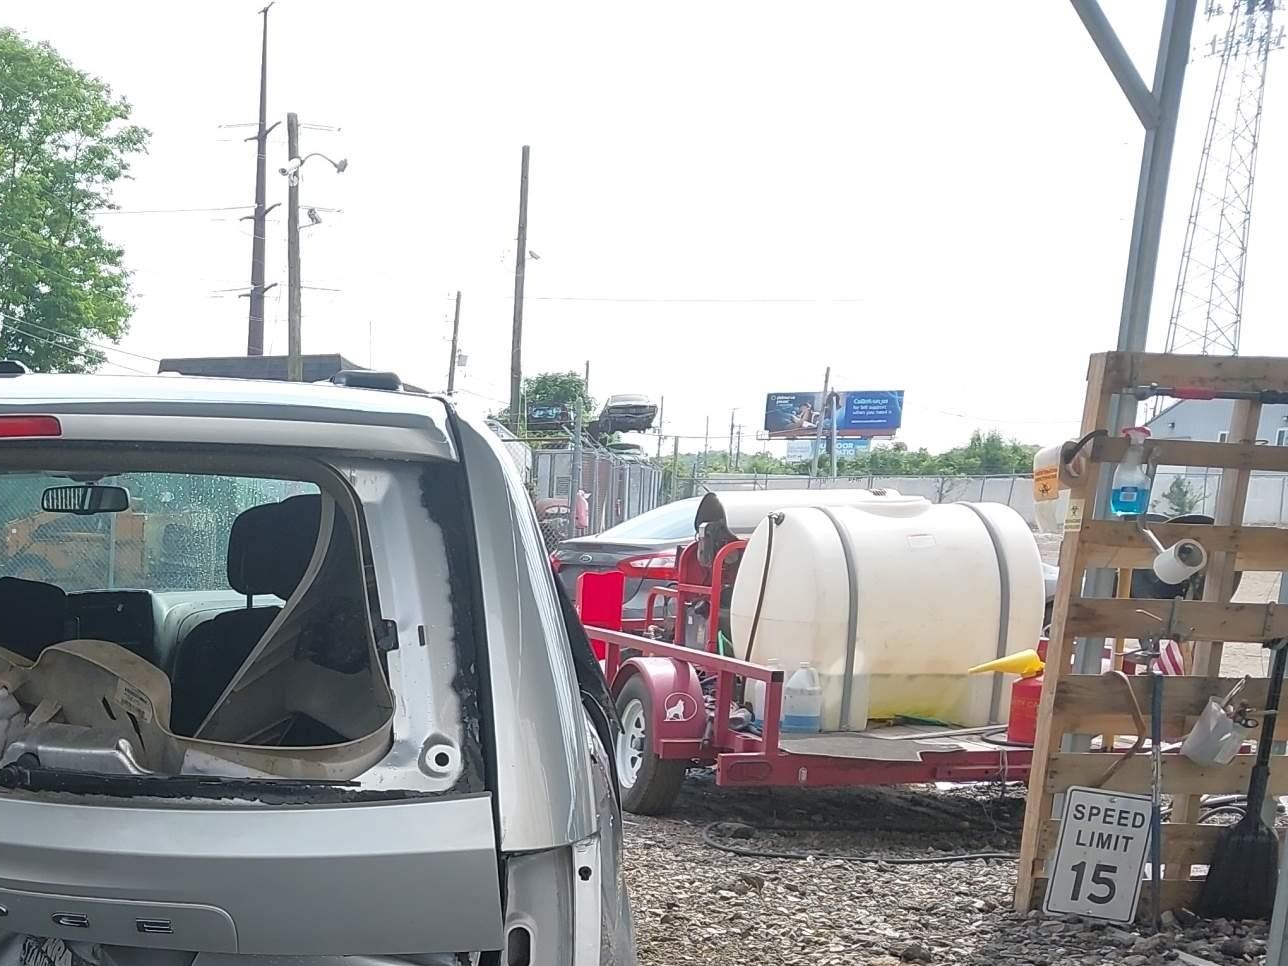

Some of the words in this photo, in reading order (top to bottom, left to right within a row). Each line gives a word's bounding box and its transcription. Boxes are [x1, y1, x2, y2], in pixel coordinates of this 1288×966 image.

[1073, 803, 1146, 829] SPEED
[1075, 829, 1134, 853] LIMIT
[1070, 861, 1118, 905] 15
